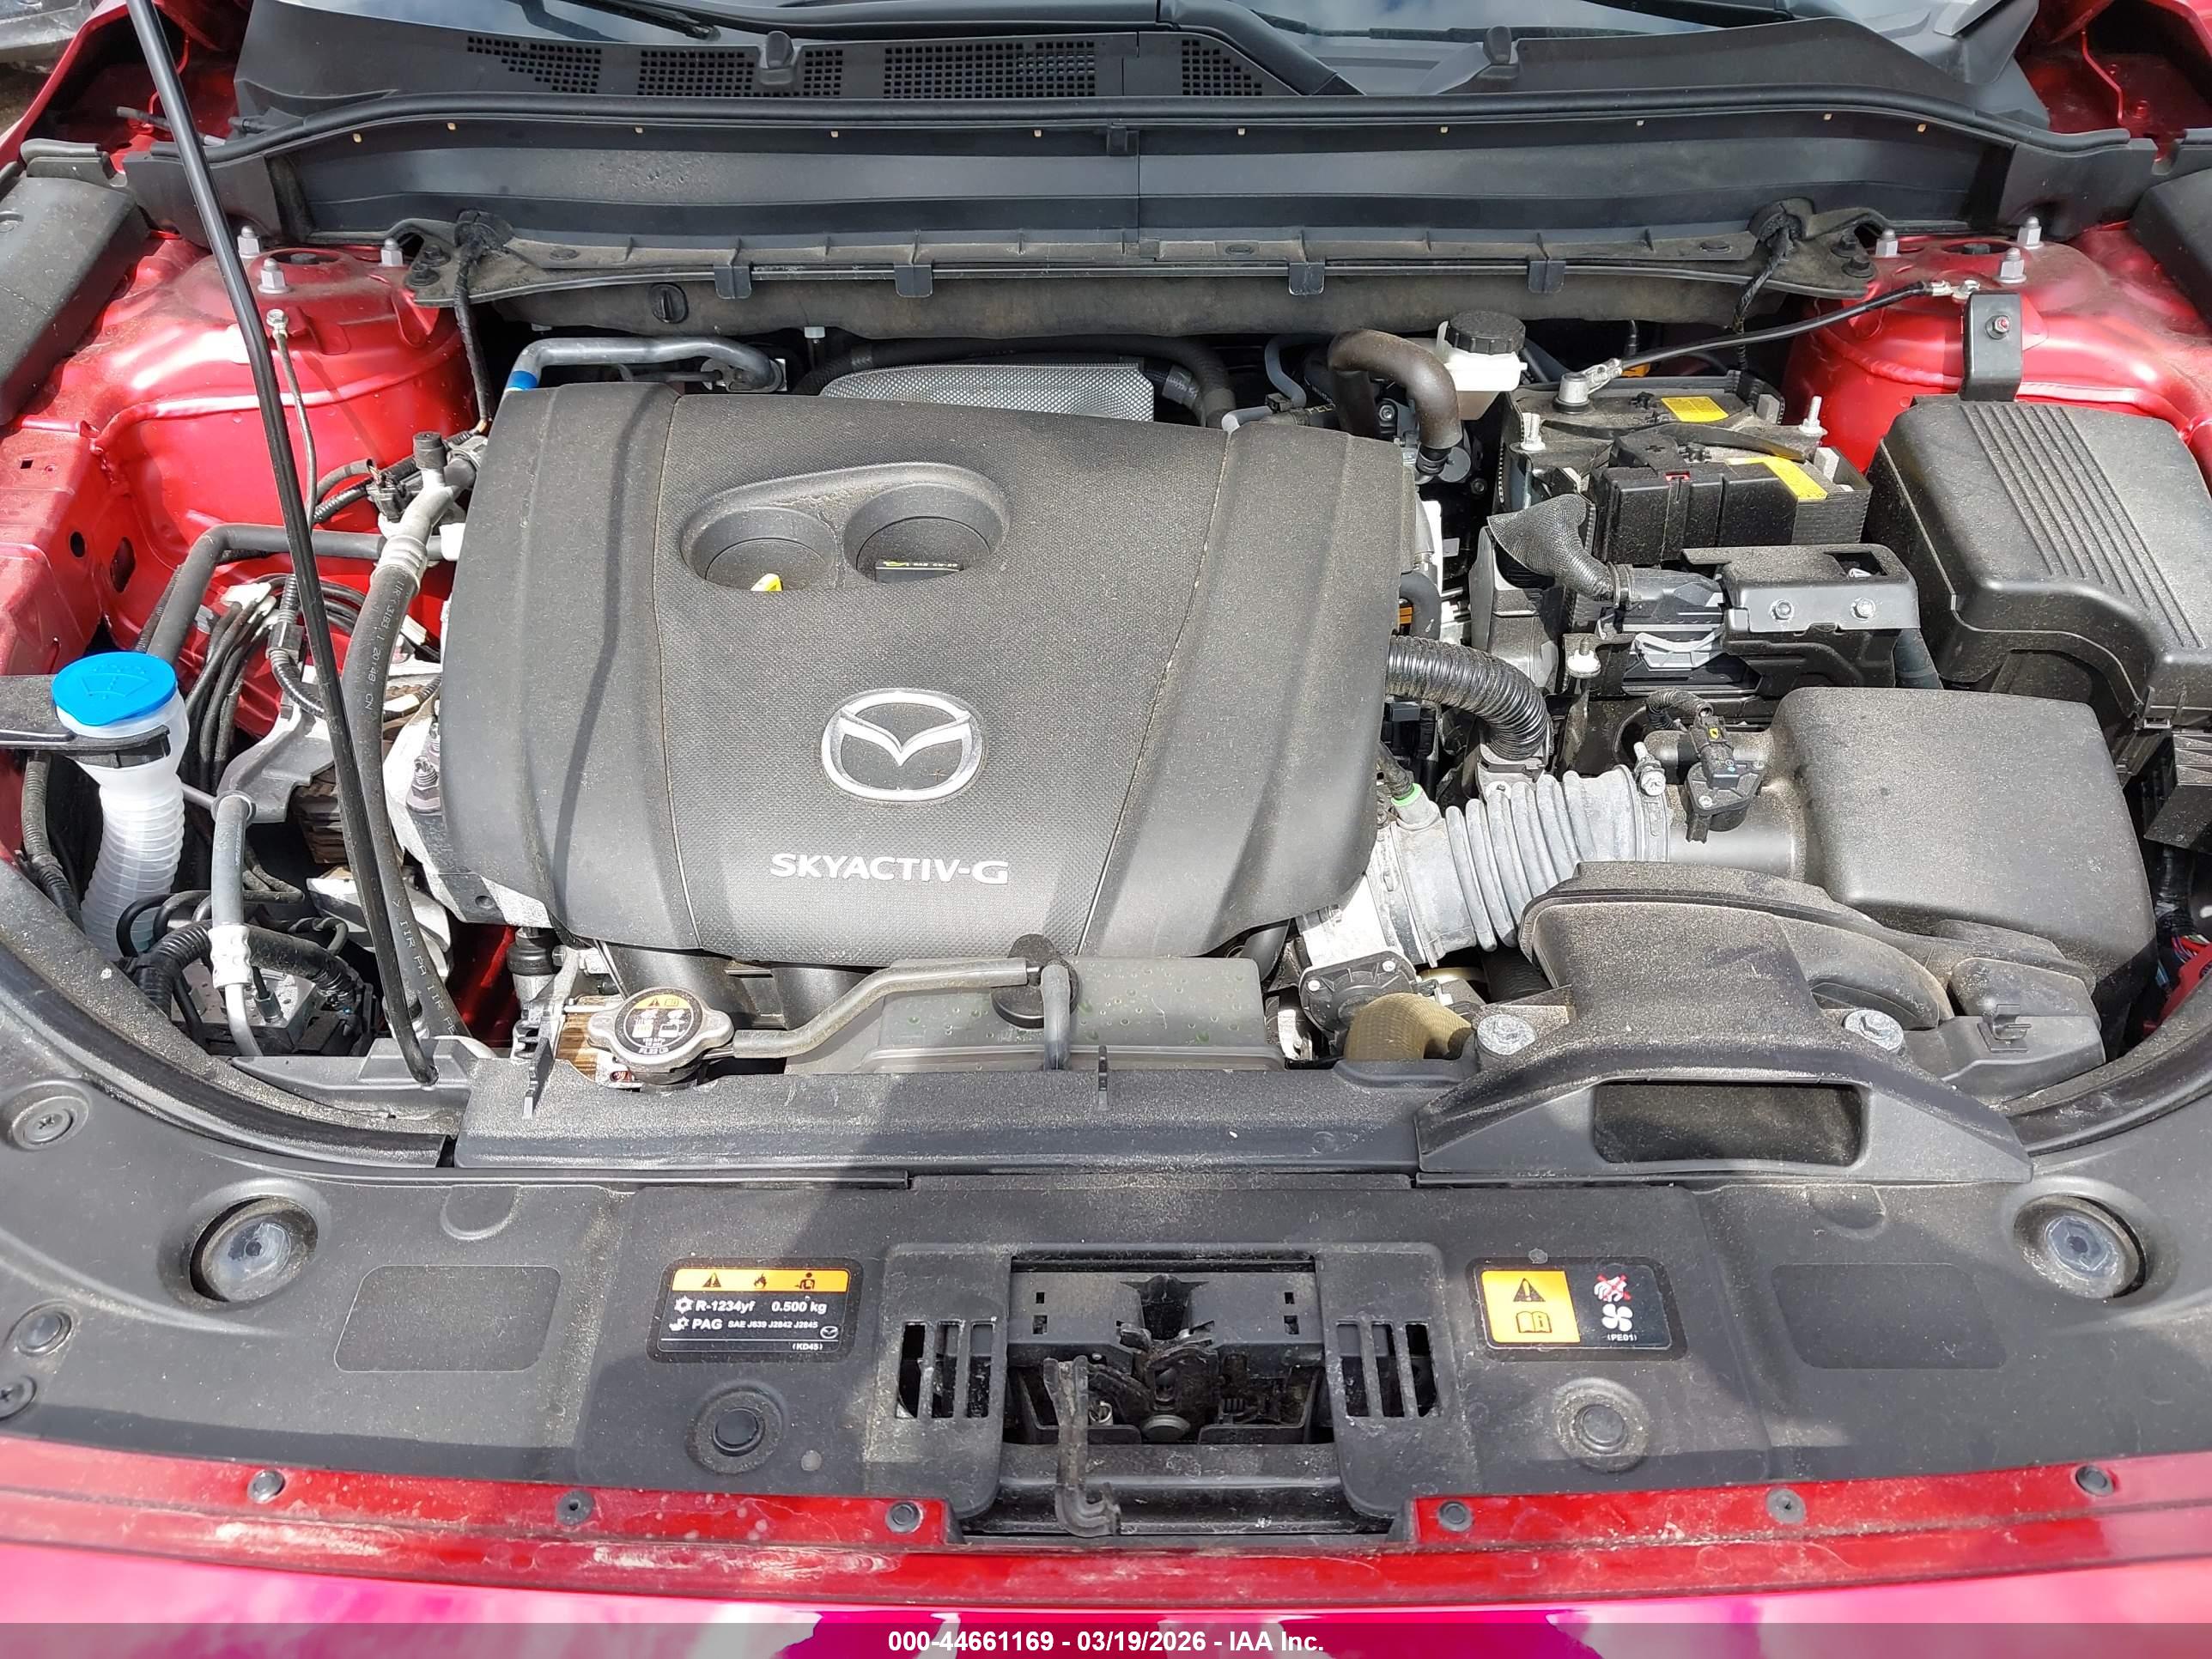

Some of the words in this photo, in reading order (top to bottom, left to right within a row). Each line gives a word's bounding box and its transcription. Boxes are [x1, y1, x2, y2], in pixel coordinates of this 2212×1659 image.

[769, 853, 1009, 884] SKYACTIV-G
[414, 955, 427, 976] PA
[696, 1299, 756, 1314] R-1234yf
[771, 1300, 807, 1313] 0.500
[810, 1300, 827, 1315] kg
[692, 1318, 723, 1330] PAG
[728, 1320, 746, 1328] SAE
[769, 1320, 793, 1329] J2842
[793, 1320, 818, 1329] J2845
[792, 1342, 823, 1351] (KD45)
